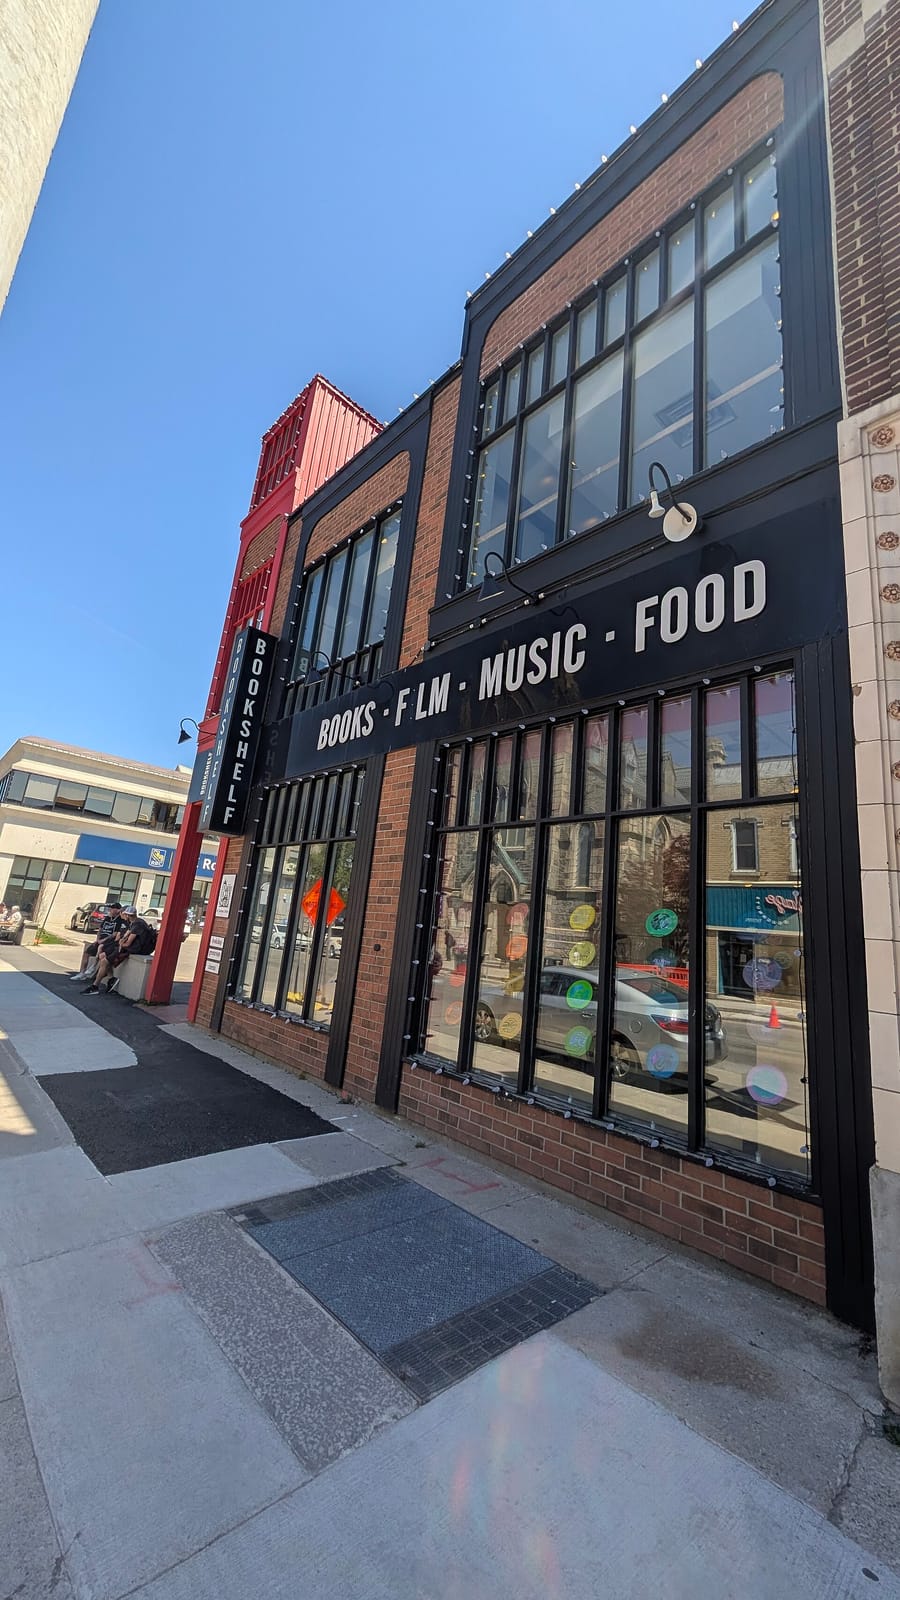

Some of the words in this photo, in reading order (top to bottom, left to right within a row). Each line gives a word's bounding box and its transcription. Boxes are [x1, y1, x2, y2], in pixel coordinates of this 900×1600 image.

[202, 637, 243, 823] BOOKSHELF
[223, 638, 266, 825] BOOKSHELF
[316, 701, 376, 751] BOOKS
[395, 672, 451, 727] FLM
[478, 623, 587, 701] MUSIC
[634, 559, 767, 653] FOOD
